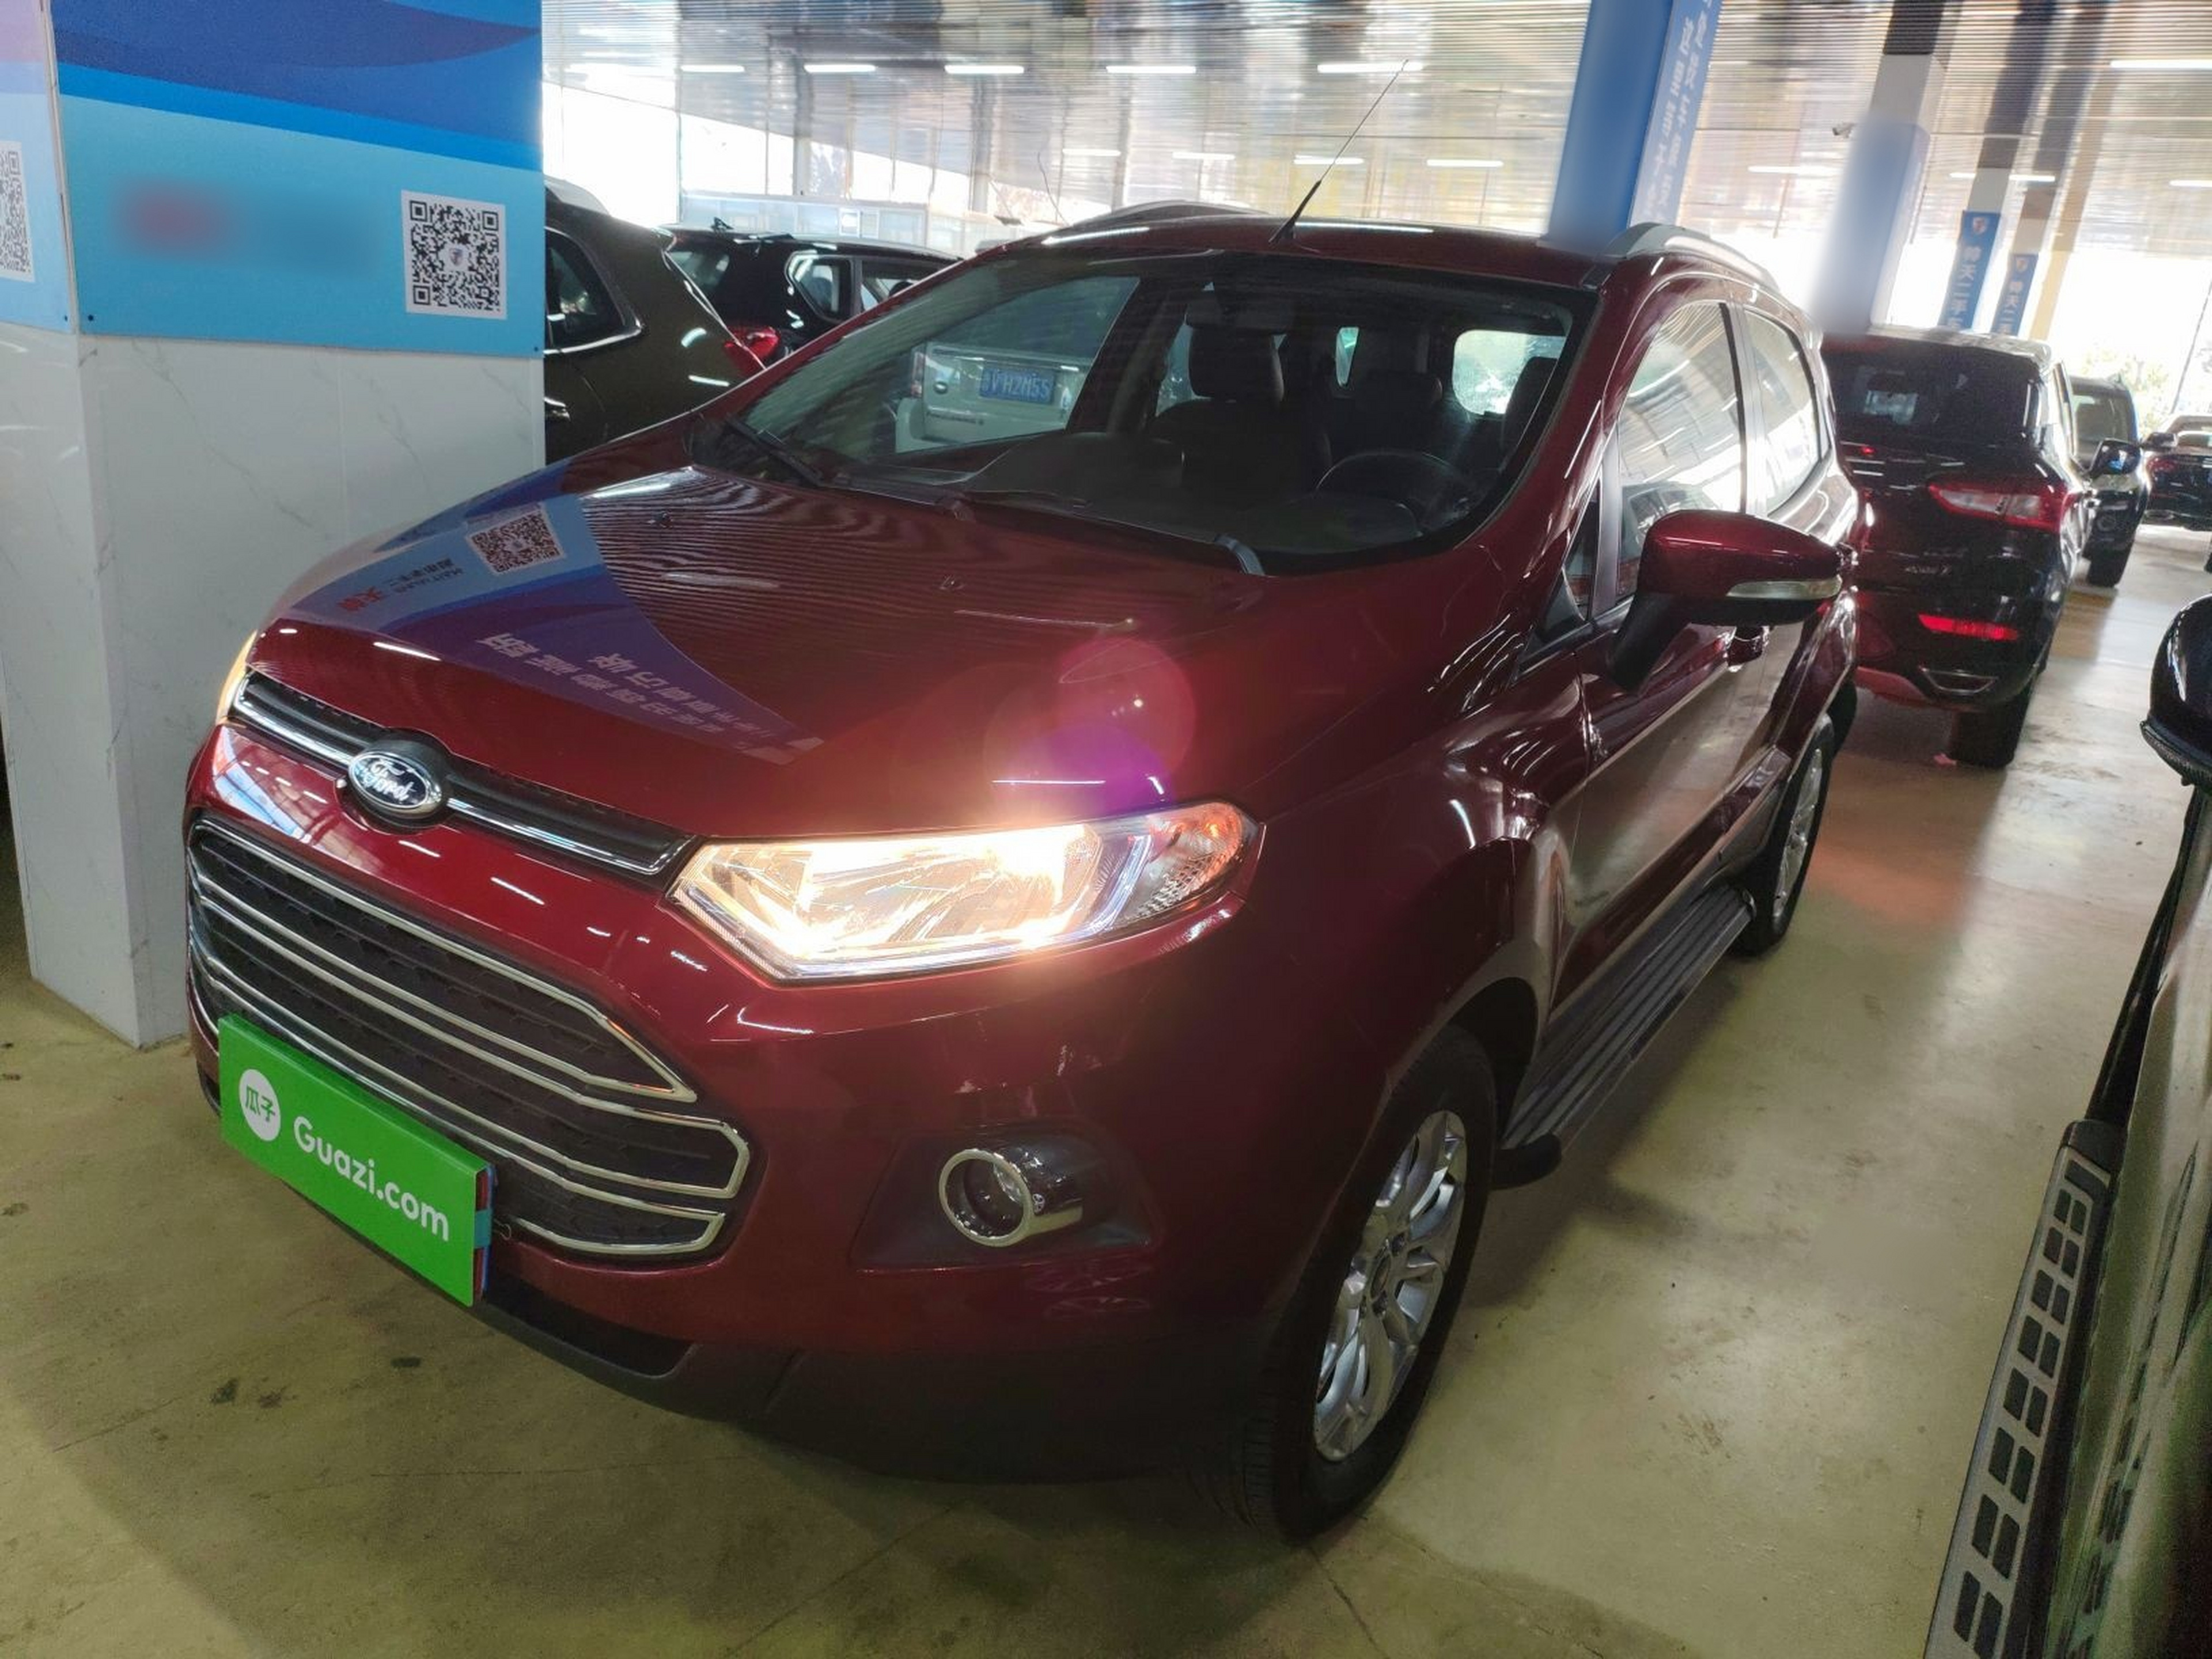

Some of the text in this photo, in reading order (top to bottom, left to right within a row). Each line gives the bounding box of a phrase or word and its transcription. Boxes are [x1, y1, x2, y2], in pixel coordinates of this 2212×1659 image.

[362, 757, 416, 801] Ford
[245, 1085, 276, 1122] 瓜子
[293, 1116, 449, 1241] Guazi.com
